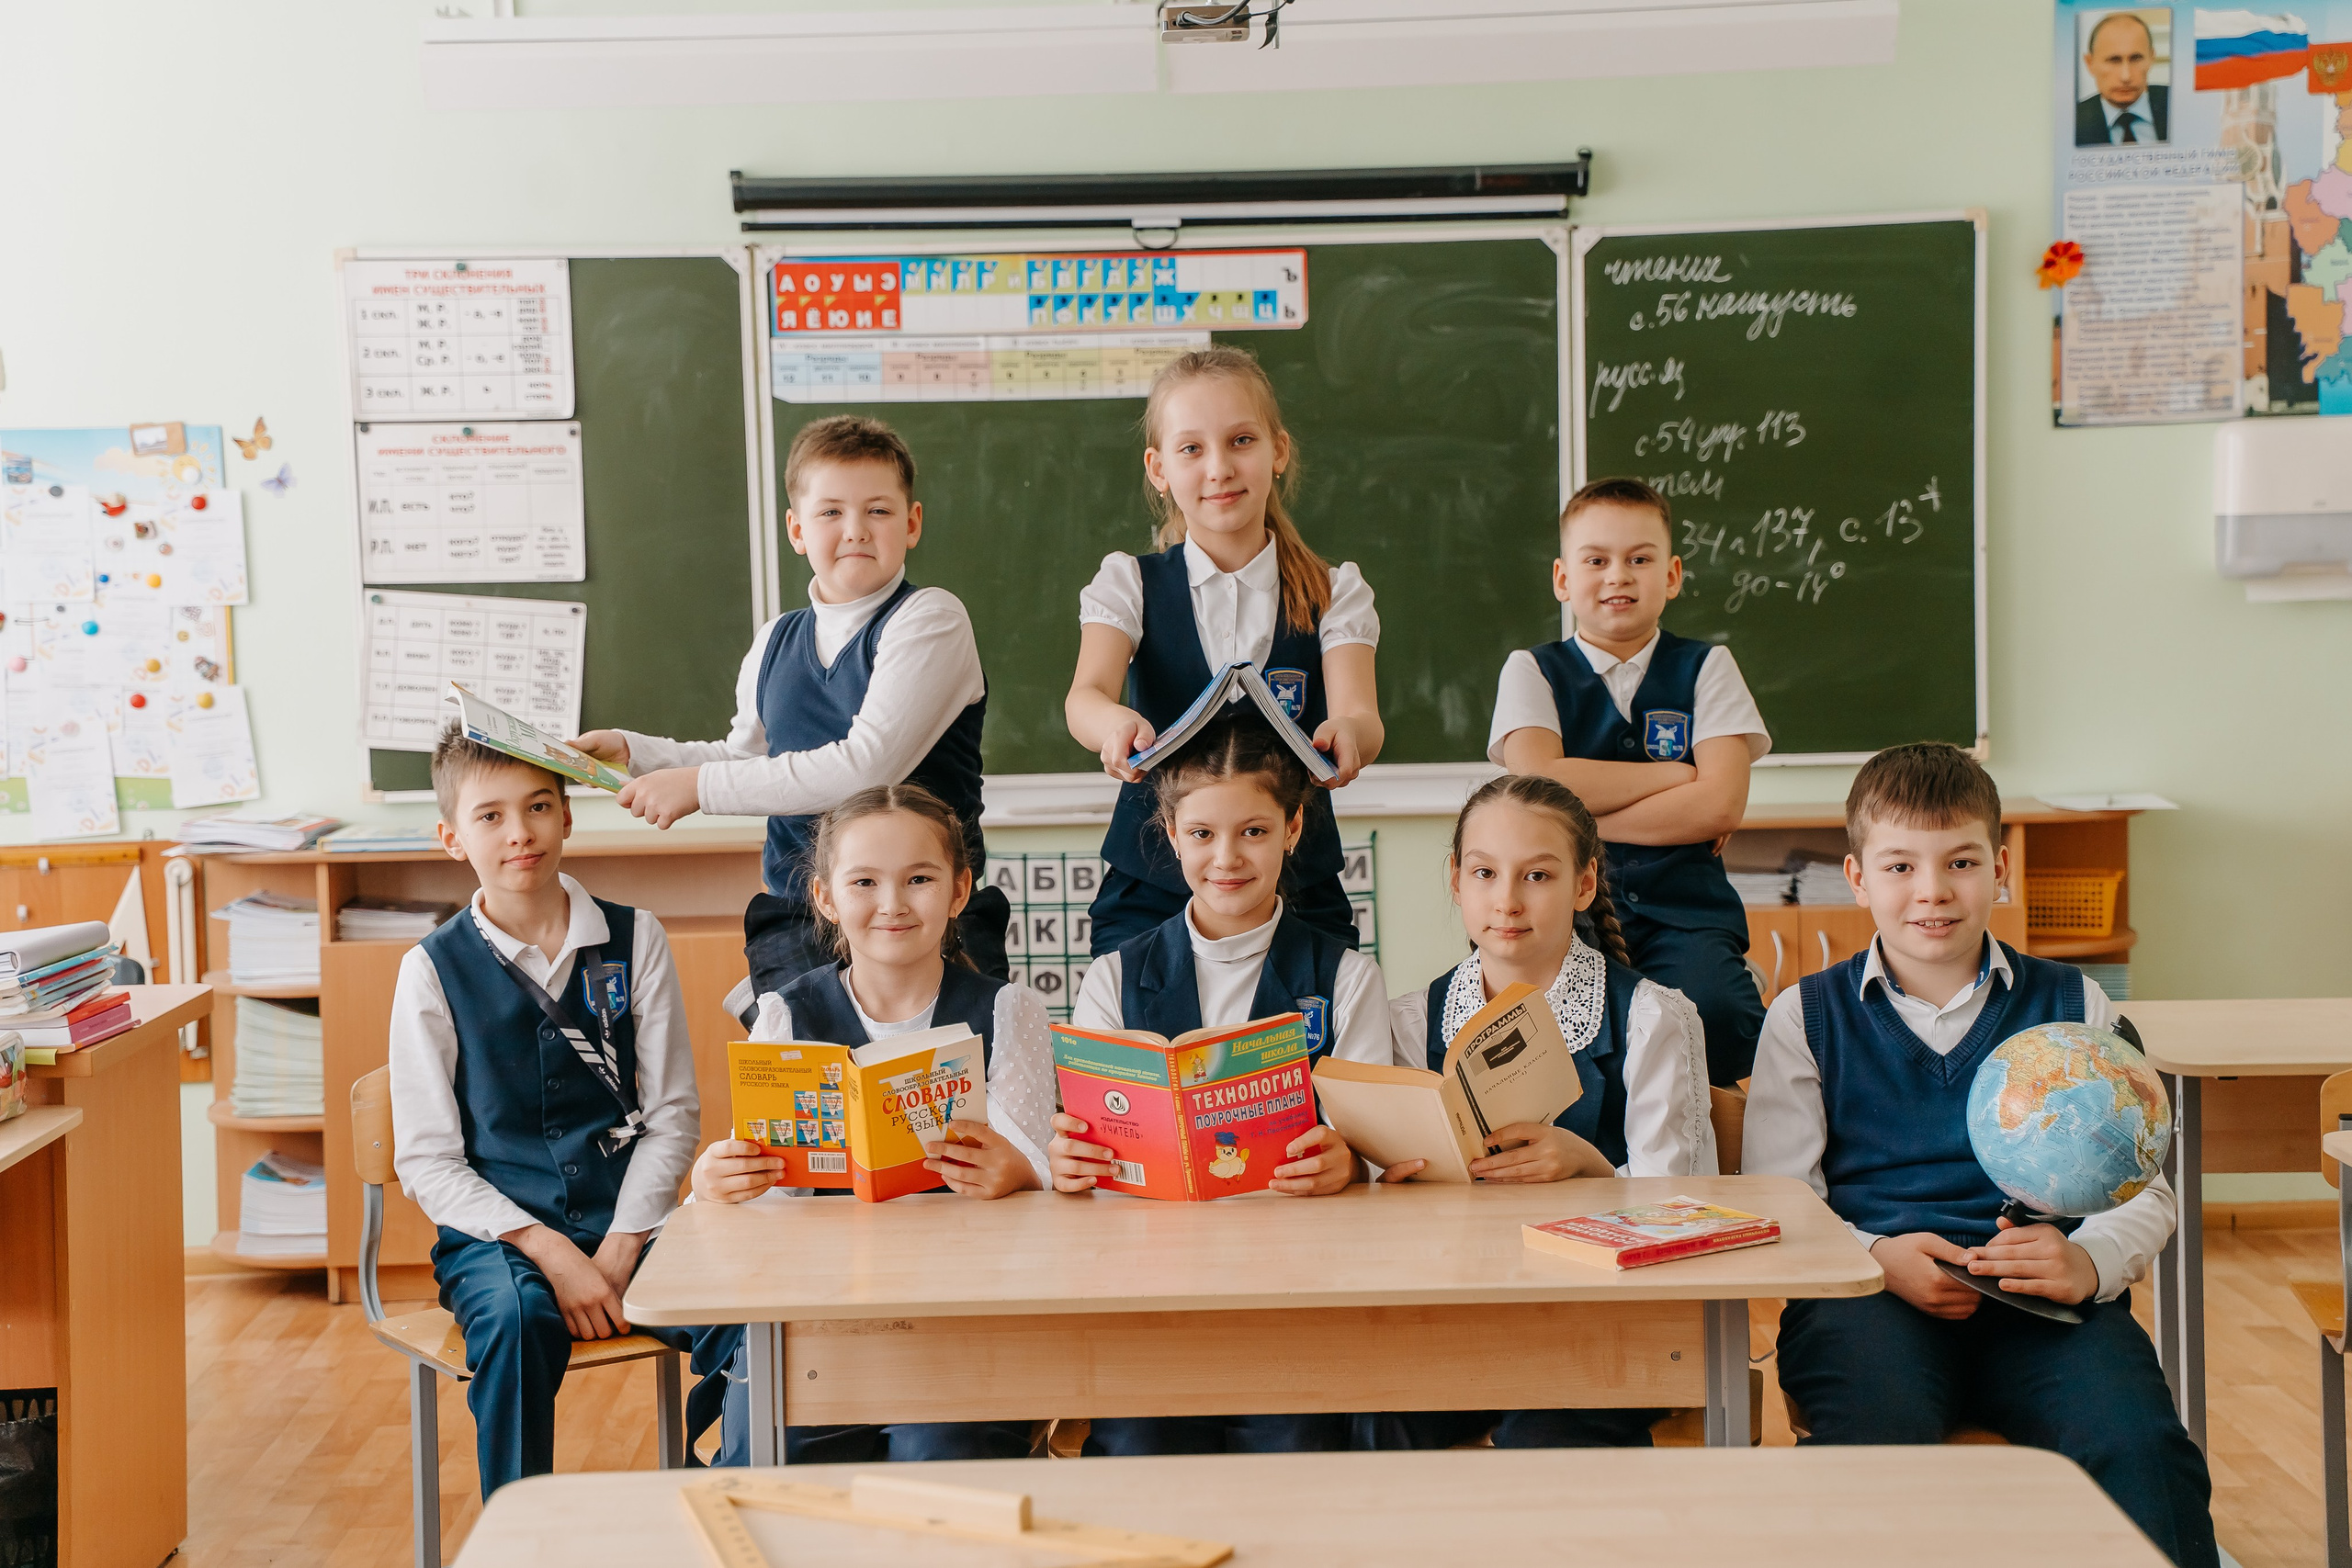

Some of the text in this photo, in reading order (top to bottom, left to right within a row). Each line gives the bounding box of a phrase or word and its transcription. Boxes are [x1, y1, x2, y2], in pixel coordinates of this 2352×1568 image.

[779, 275, 796, 292] А
[804, 274, 820, 292] О
[830, 274, 845, 292] У
[854, 275, 872, 292] Ы
[881, 272, 897, 291] Э
[981, 273, 995, 289] Р
[1031, 271, 1046, 288] Б
[1083, 270, 1095, 286] Г
[1154, 268, 1175, 286] Ж
[782, 310, 797, 328] Я
[806, 308, 821, 328] Ё
[828, 310, 849, 328] Ю
[855, 310, 872, 328] И
[881, 310, 897, 328] Е
[1032, 308, 1046, 324] П
[1082, 308, 1097, 323] К
[1757, 410, 1807, 448] 113
[1035, 867, 1055, 890] Б
[1073, 867, 1094, 890] В
[1035, 919, 1056, 942] К
[1035, 971, 1062, 995] Ф
[1232, 1028, 1295, 1054] Начальная
[1307, 1032, 1320, 1041] №76
[1464, 1003, 1527, 1058] ПРОГРАММЫ
[1261, 1043, 1298, 1060] школа
[739, 1066, 812, 1074] СЛОВООБРАЗОВАТЕЛЬНЫЙ
[739, 1073, 777, 1081] СЛОВАРЬ
[904, 1068, 946, 1085] ШКОЛЬНЫЙ
[1168, 1054, 1180, 1091] ТЕХНОЛОГИЯ
[1484, 1069, 1521, 1095] НАЧАЛЬНЫЕ
[1523, 1050, 1548, 1069] КЛАССЫ
[605, 1075, 618, 1091] adidas
[882, 1068, 969, 1097] СЛОВООБРАЗОВАТЕЛЬНЫЙ
[1193, 1067, 1303, 1111] ТЕХНОЛОГИЯ
[882, 1077, 972, 1114] СЛОВАРЬ
[891, 1098, 967, 1126] РУССКОГО
[1101, 1116, 1139, 1127] ИЗДАТЕЛЬСТВО
[1195, 1089, 1306, 1130] ПОУРОЧНЫЕ ПЛАНЫ
[906, 1113, 953, 1134] ЯЗЫКА
